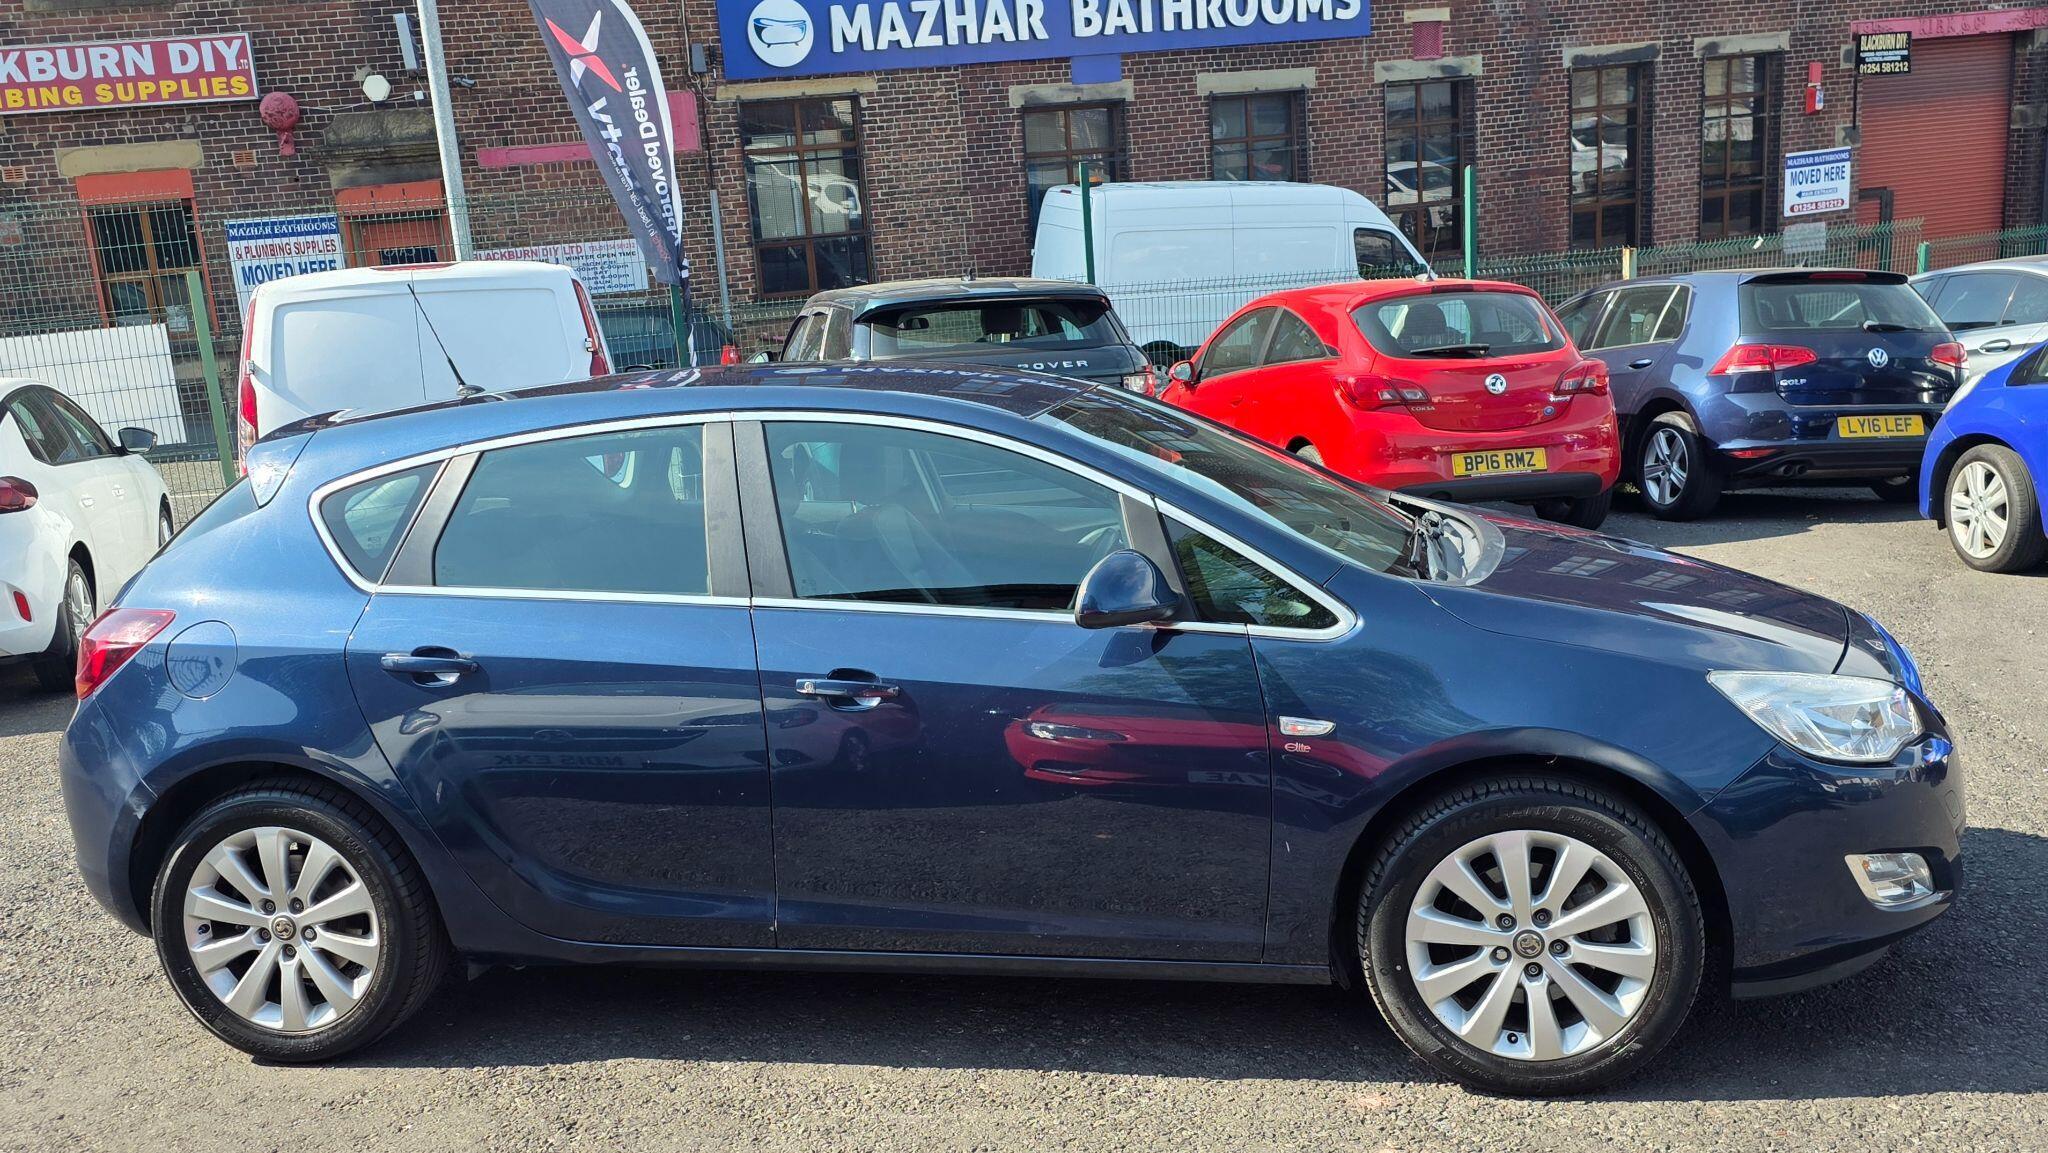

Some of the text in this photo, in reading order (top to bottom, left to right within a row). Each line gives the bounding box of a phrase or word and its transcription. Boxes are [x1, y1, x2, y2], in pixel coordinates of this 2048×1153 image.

[829, 0, 1049, 53] MAZHAR
[1860, 33, 1908, 51] BLACKBURN DIY
[166, 38, 243, 74] DIY
[1860, 61, 1909, 74] 01254 581212
[0, 75, 249, 109] BING SUPPLIES
[1786, 151, 1850, 166] MAZHAR BATHROOMS
[1790, 165, 1846, 187] MOVED HERE
[1793, 202, 1816, 212] 01254
[228, 221, 337, 237] MAZHAR BATHROOMS
[235, 239, 338, 260] & PLUMBING SUPPLIES
[542, 246, 560, 257] DIY
[563, 245, 584, 255] LTD
[565, 254, 594, 262] WINTER
[241, 262, 294, 286] MOVED
[1780, 378, 1807, 387] GOLF
[1411, 404, 1436, 412] CORSA
[1848, 417, 1913, 434] LY16 LEF
[1463, 451, 1537, 472] BP16 RMZ
